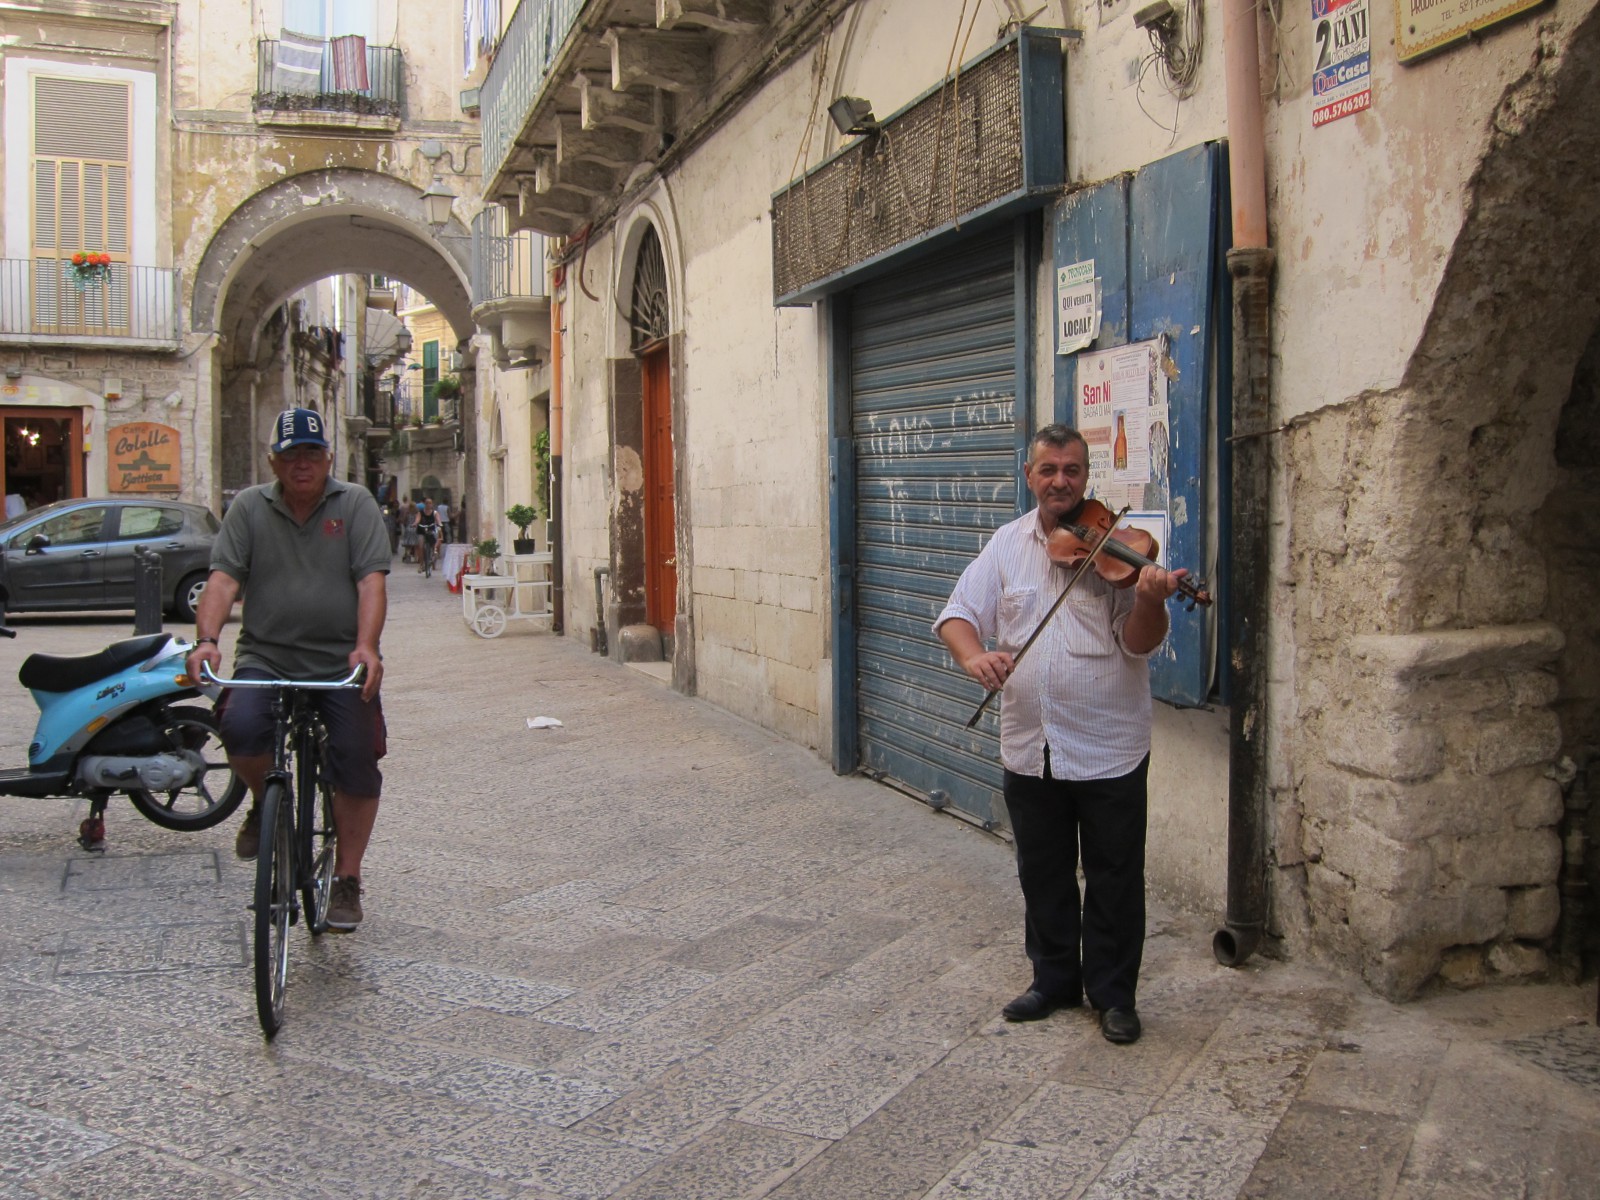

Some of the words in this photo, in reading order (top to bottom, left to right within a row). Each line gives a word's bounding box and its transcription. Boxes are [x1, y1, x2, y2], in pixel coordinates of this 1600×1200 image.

[1315, 20, 1332, 70] 2
[1333, 8, 1368, 50] VANI
[1313, 92, 1370, 124] 080.5746202
[1062, 295, 1073, 310] QUI
[1073, 293, 1092, 306] VENDITA
[1063, 316, 1092, 338] LOCALE
[1083, 384, 1101, 406] San
[306, 416, 319, 433] B
